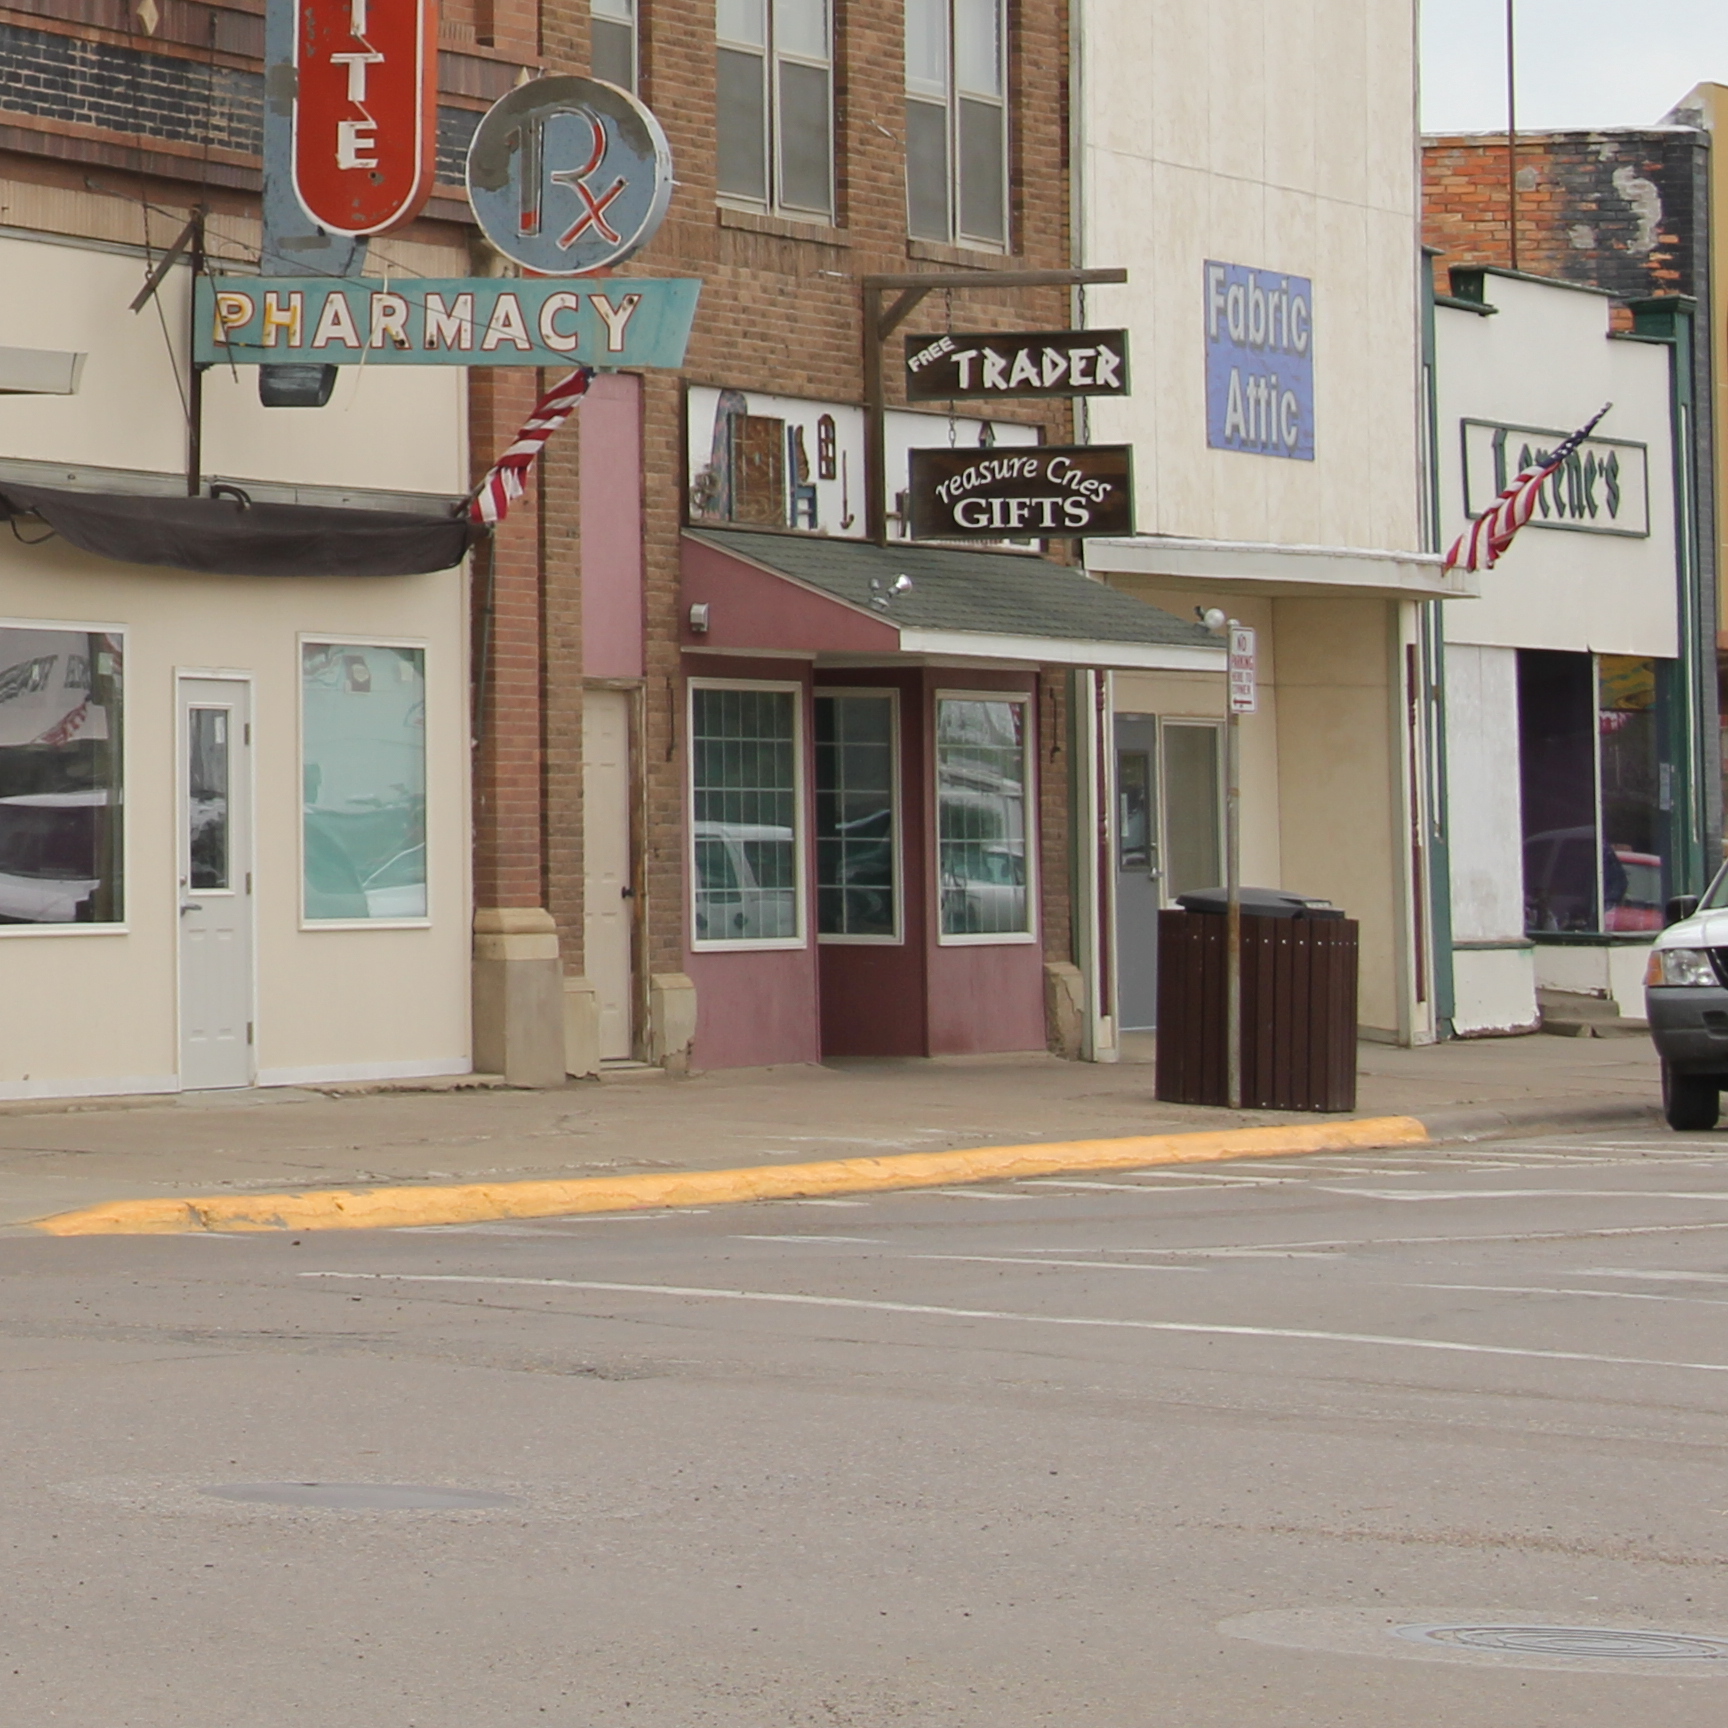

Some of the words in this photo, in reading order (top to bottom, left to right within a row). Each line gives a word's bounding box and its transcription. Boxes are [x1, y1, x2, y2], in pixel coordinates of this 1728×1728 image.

[211, 290, 643, 354] PHARMACY
[1208, 265, 1310, 355] Fabric
[907, 335, 957, 373] FREE
[950, 344, 1121, 390] TRADER
[1225, 367, 1299, 449] Attic
[953, 495, 1090, 529] GIFTS
